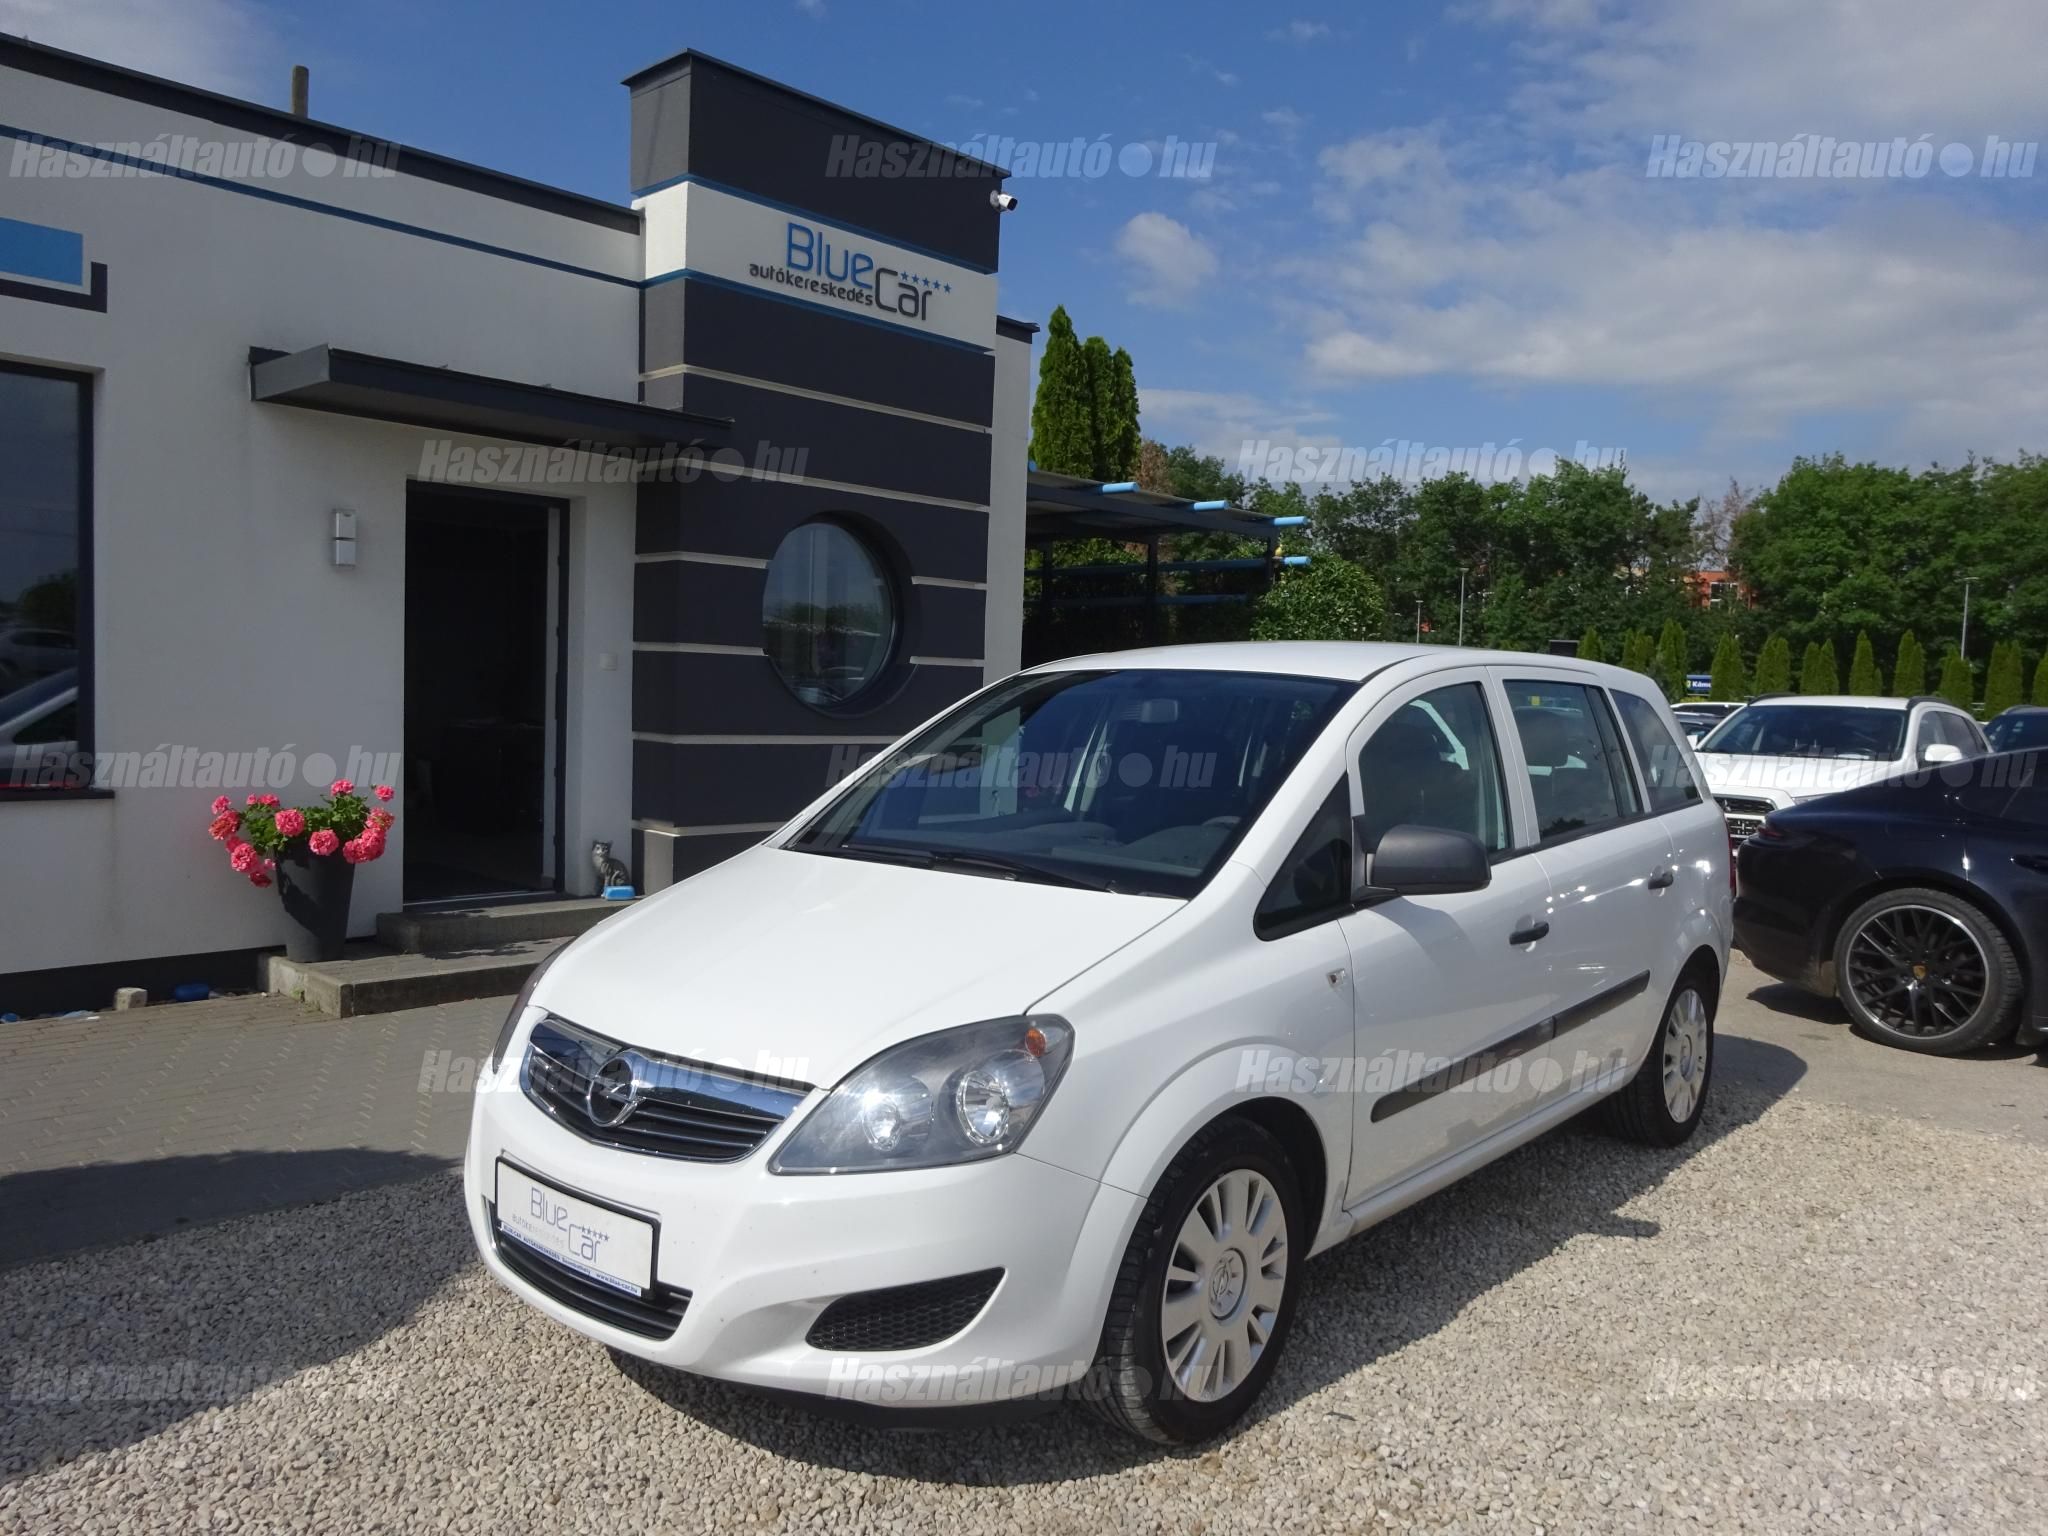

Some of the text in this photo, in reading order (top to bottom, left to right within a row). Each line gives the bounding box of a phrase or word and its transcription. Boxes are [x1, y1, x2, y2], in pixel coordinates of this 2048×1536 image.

[786, 222, 874, 290] Blue
[749, 263, 874, 307] autókereskedés
[875, 267, 933, 321] Car
[530, 1186, 568, 1232] Blue
[568, 1223, 601, 1263] Car
